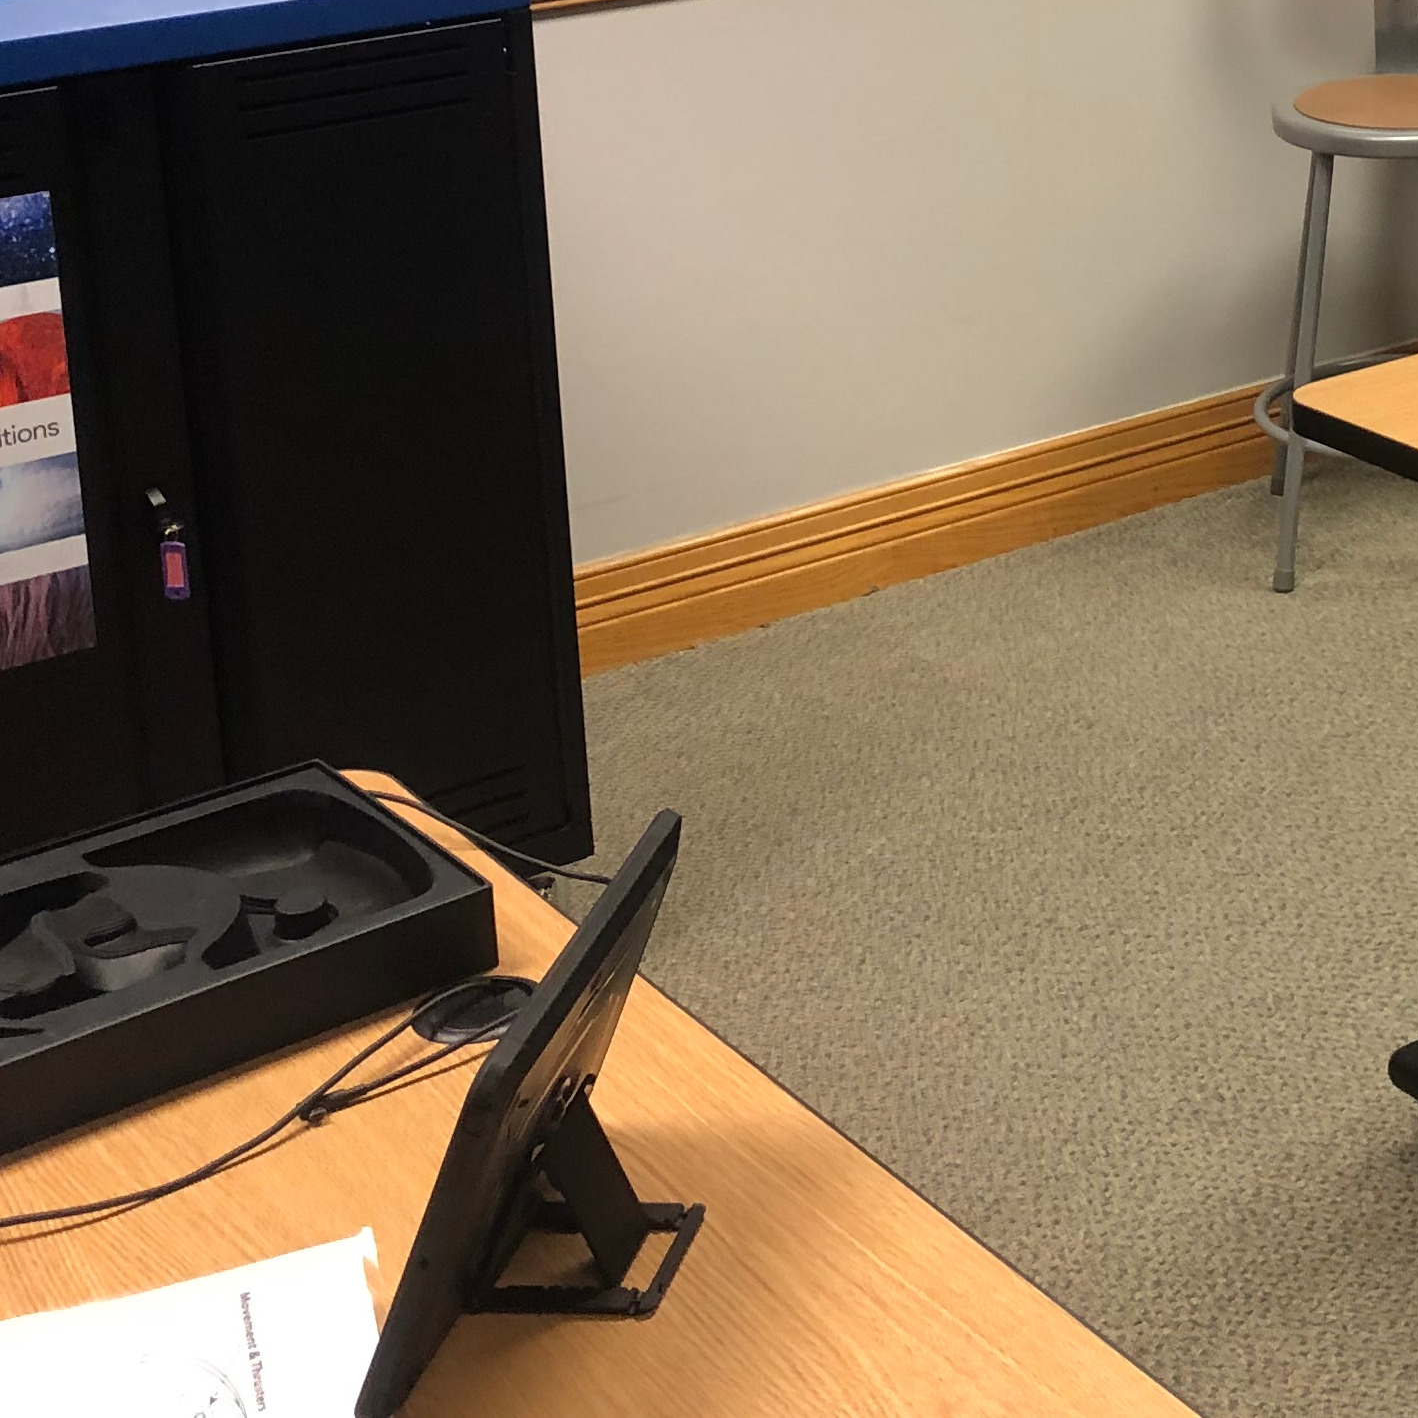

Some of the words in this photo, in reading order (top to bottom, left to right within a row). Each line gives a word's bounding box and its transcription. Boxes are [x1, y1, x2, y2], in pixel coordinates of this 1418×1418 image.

[0, 422, 60, 448] tions
[240, 1291, 257, 1349] Movement
[249, 1351, 261, 1360] &
[252, 1360, 266, 1412] Thrusters
